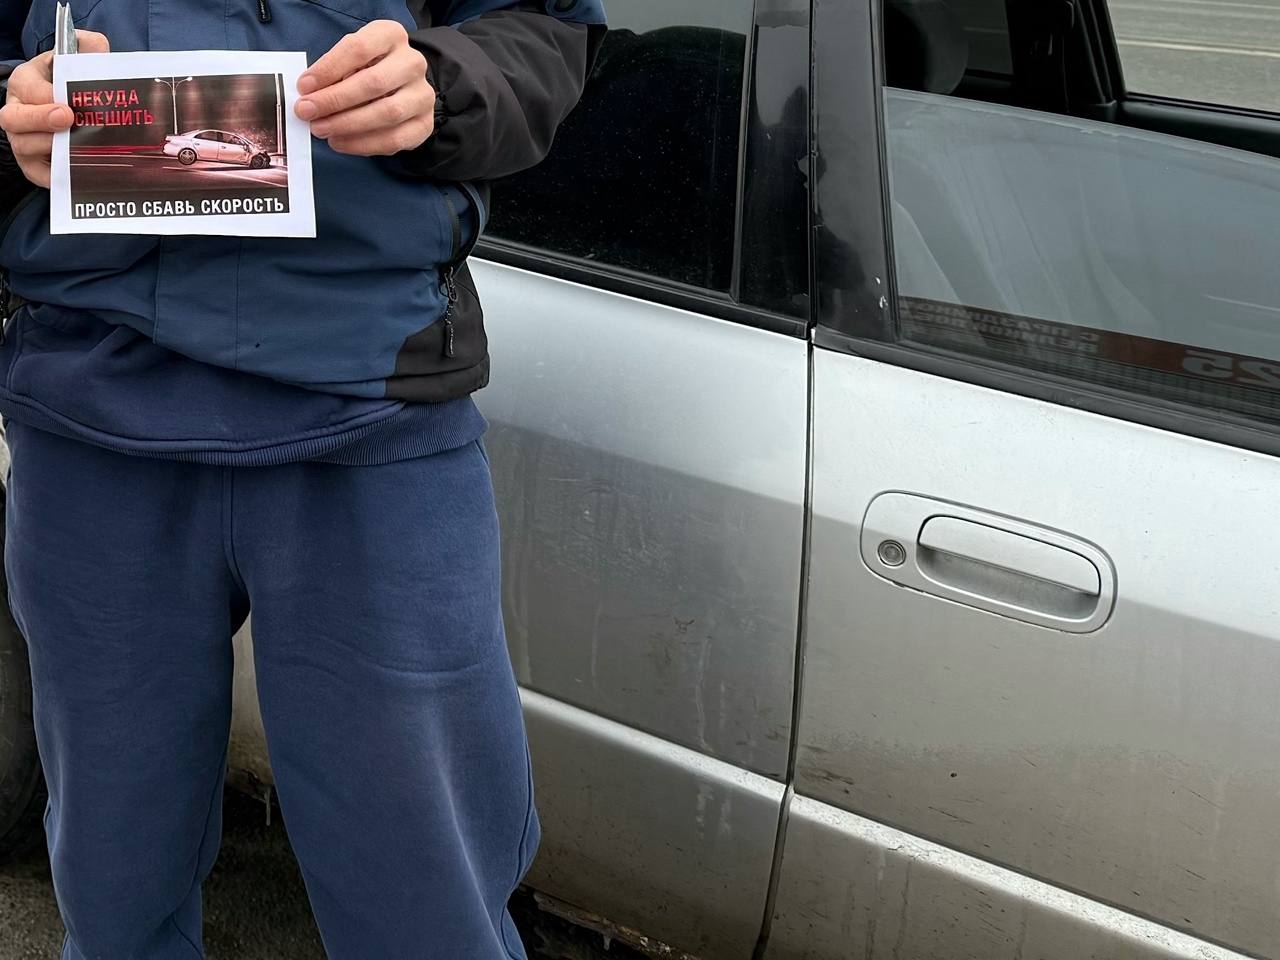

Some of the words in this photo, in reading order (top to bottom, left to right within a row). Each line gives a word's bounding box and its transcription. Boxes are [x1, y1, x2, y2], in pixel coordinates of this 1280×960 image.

[72, 89, 140, 108] НЕКУДА
[75, 109, 156, 127] СПЕШИТЬ
[75, 202, 137, 218] ПРОСТО
[142, 201, 195, 216] СБАВЬ
[201, 197, 285, 214] СКОРОСТЬ
